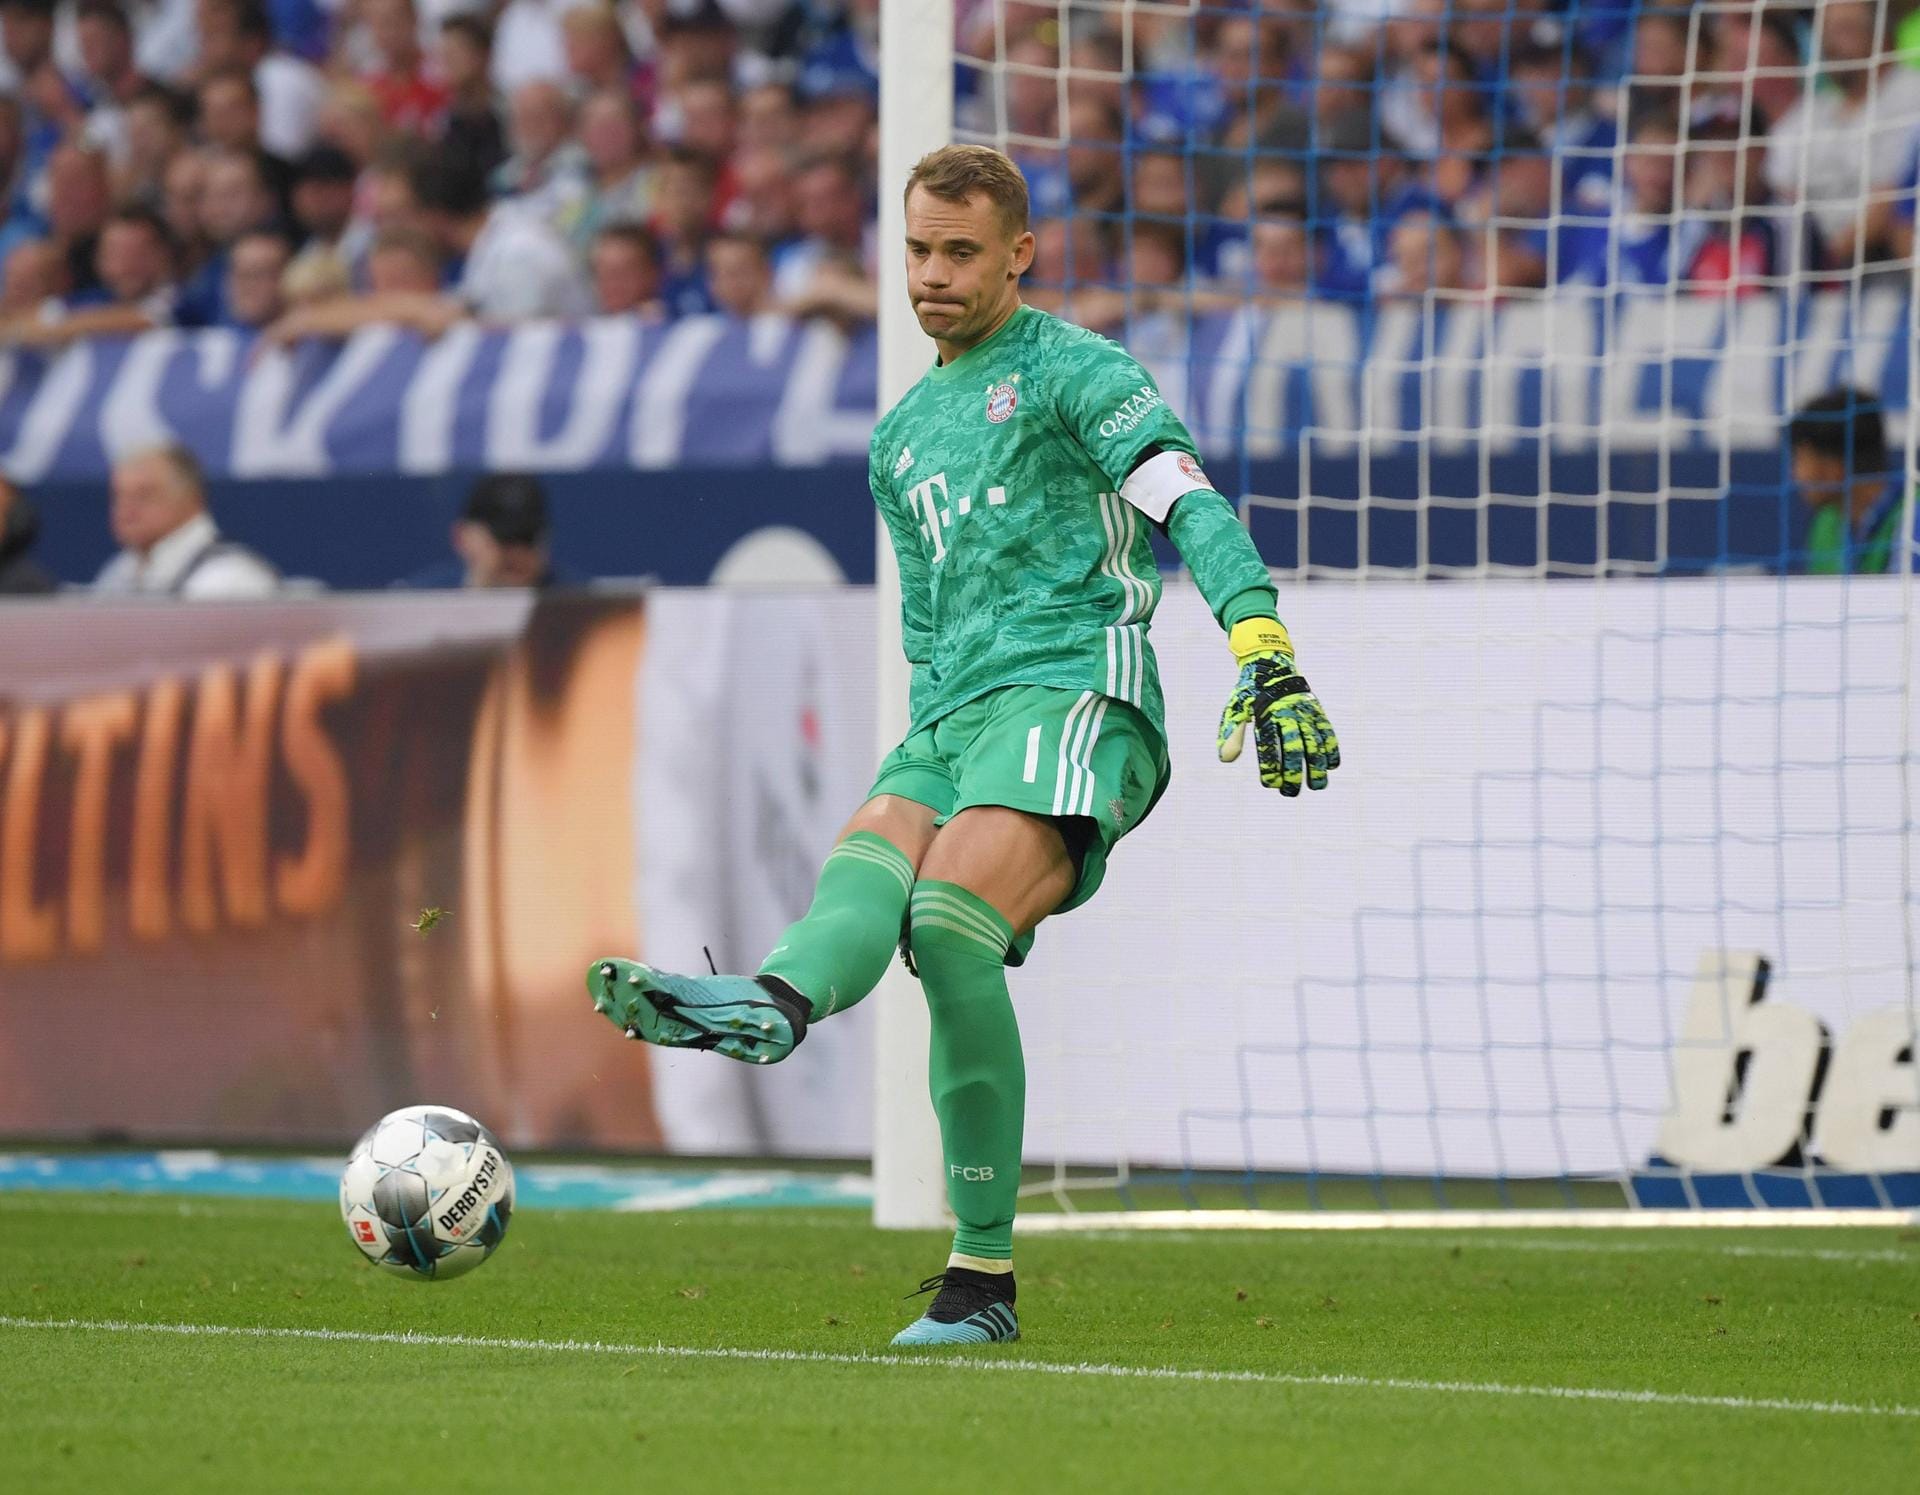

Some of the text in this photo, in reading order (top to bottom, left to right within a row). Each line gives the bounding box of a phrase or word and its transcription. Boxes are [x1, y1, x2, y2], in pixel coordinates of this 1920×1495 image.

[1099, 386, 1158, 437] QATAR
[1123, 396, 1164, 434] AIRWAYS
[1022, 724, 1042, 784] 1
[0, 635, 356, 962] LTINS
[438, 1150, 499, 1232] DERBYSTAR
[950, 1163, 995, 1181] FCB
